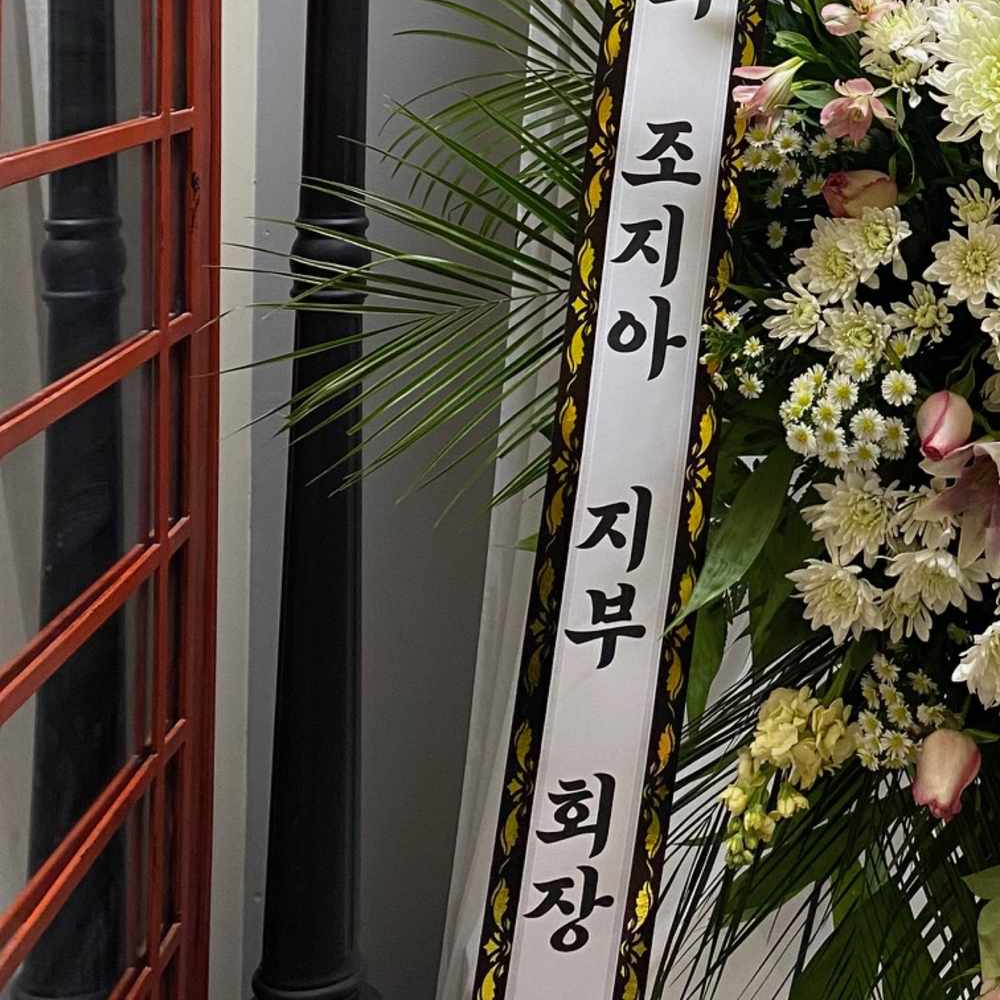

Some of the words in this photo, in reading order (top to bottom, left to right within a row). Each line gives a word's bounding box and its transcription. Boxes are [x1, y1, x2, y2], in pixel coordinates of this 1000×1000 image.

[607, 121, 702, 381] 조지아
[564, 485, 653, 669] 지부
[522, 772, 616, 952] 회장
